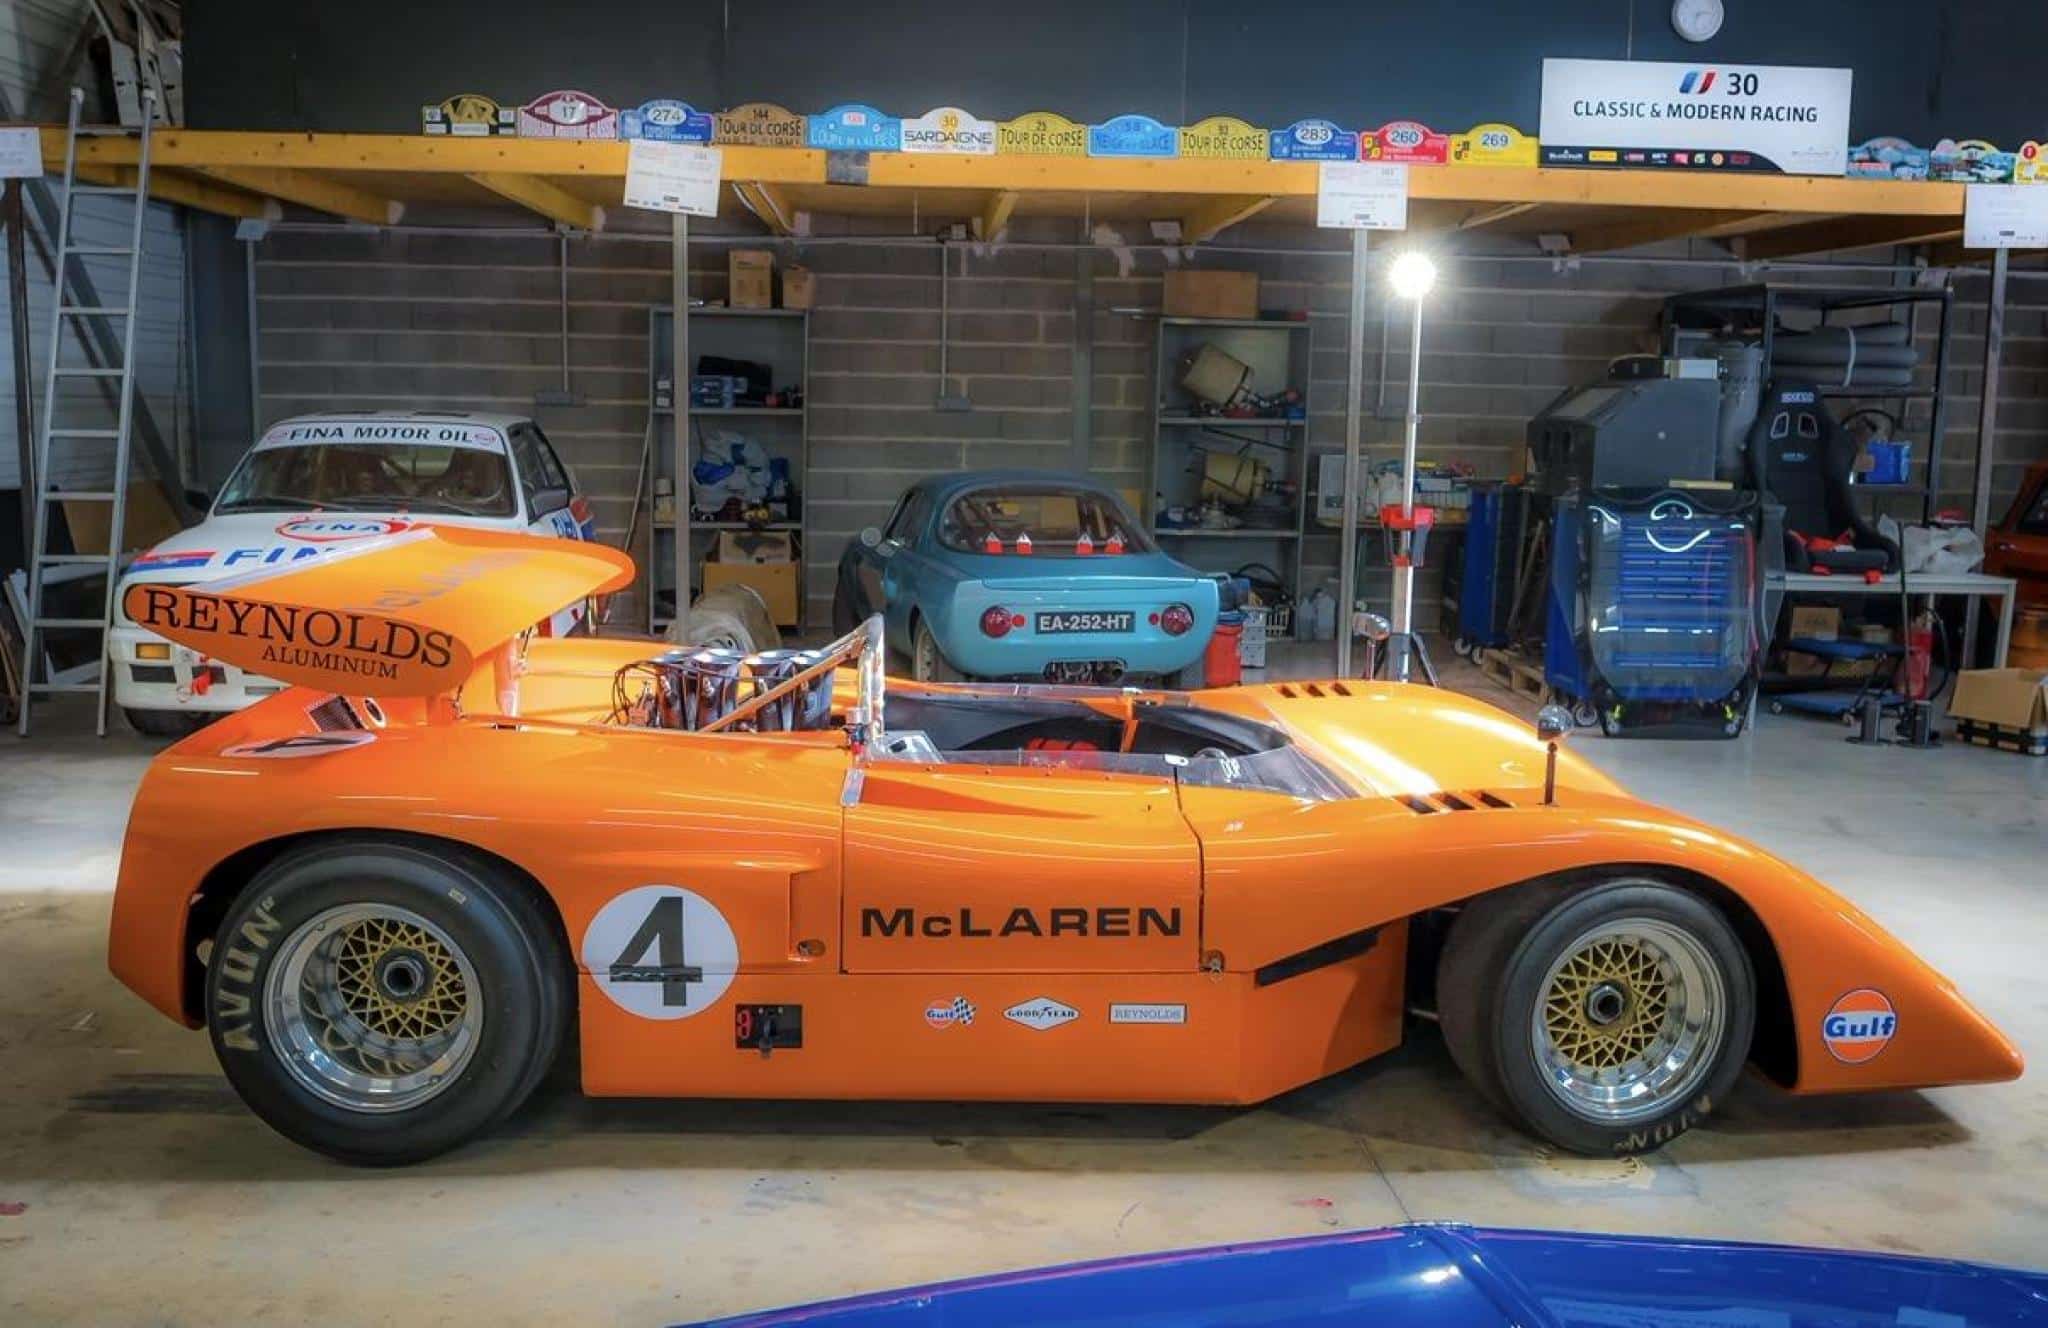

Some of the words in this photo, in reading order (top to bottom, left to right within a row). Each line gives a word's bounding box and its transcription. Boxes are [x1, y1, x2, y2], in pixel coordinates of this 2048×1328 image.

[1727, 73, 1758, 96] 30
[653, 109, 680, 121] 274
[1573, 100, 1645, 118] CLASSIC
[1650, 104, 1661, 118] &
[1667, 103, 1745, 121] MODERN
[1751, 105, 1818, 122] RACING
[719, 117, 746, 134] TOUR
[767, 120, 801, 136] CORSE
[1300, 128, 1329, 141] 283
[904, 130, 993, 144] SARDAIGNE
[1000, 128, 1029, 145] TOUR
[1032, 132, 1046, 145] DE
[1049, 129, 1082, 146] CORSE
[1182, 132, 1210, 149] TOUR
[1214, 136, 1227, 150] DE
[1230, 134, 1264, 151] CORSE
[1391, 129, 1419, 144] 260
[1482, 134, 1509, 146] 269
[289, 427, 344, 441] FINA
[353, 426, 431, 439] MOTOR
[439, 429, 473, 442] OIL
[144, 588, 454, 668] REYNOLDS
[1040, 614, 1131, 631] EA-252-HT
[262, 645, 398, 680] ALUMINUM
[861, 907, 1182, 937] McLAREN
[609, 896, 703, 1006] 4
[217, 905, 281, 1051] AVON
[927, 1009, 954, 1019] Gulf
[1114, 1009, 1181, 1020] REYNOLDS
[1825, 1016, 1894, 1037] Gulf
